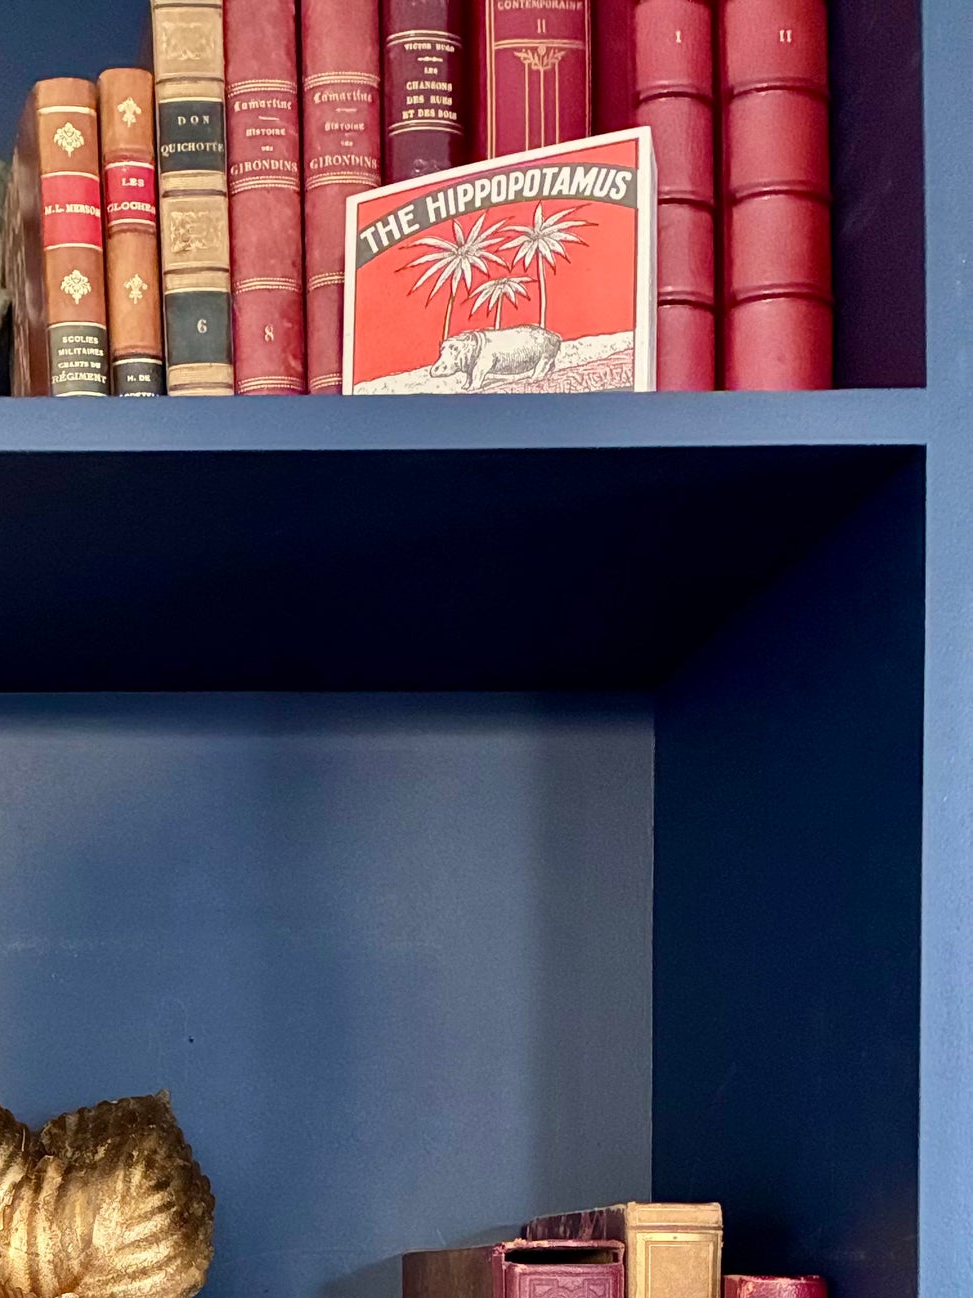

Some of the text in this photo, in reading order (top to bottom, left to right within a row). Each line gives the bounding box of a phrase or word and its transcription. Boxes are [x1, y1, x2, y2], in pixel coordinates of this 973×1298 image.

[779, 30, 792, 43] II
[404, 43, 431, 51] VICTOR
[406, 81, 452, 92] CHANSONS
[406, 95, 452, 106] DES RUES
[177, 115, 210, 126] DON
[402, 110, 415, 120] ET
[418, 109, 435, 118] DES
[161, 142, 225, 157] QUICHOTTE
[230, 159, 298, 175] GIRONDINS
[309, 154, 377, 169] GIRONDINS
[122, 178, 144, 187] LES
[107, 201, 156, 214] CLOCHES
[360, 166, 632, 254] THE HIPPOPOTAMUS
[197, 318, 207, 334] 6
[264, 324, 274, 342] 8
[62, 335, 99, 345] SCOLIES
[58, 347, 104, 357] MILITAIRES
[52, 371, 107, 384] RÉGIMENT
[139, 374, 151, 382] DE
